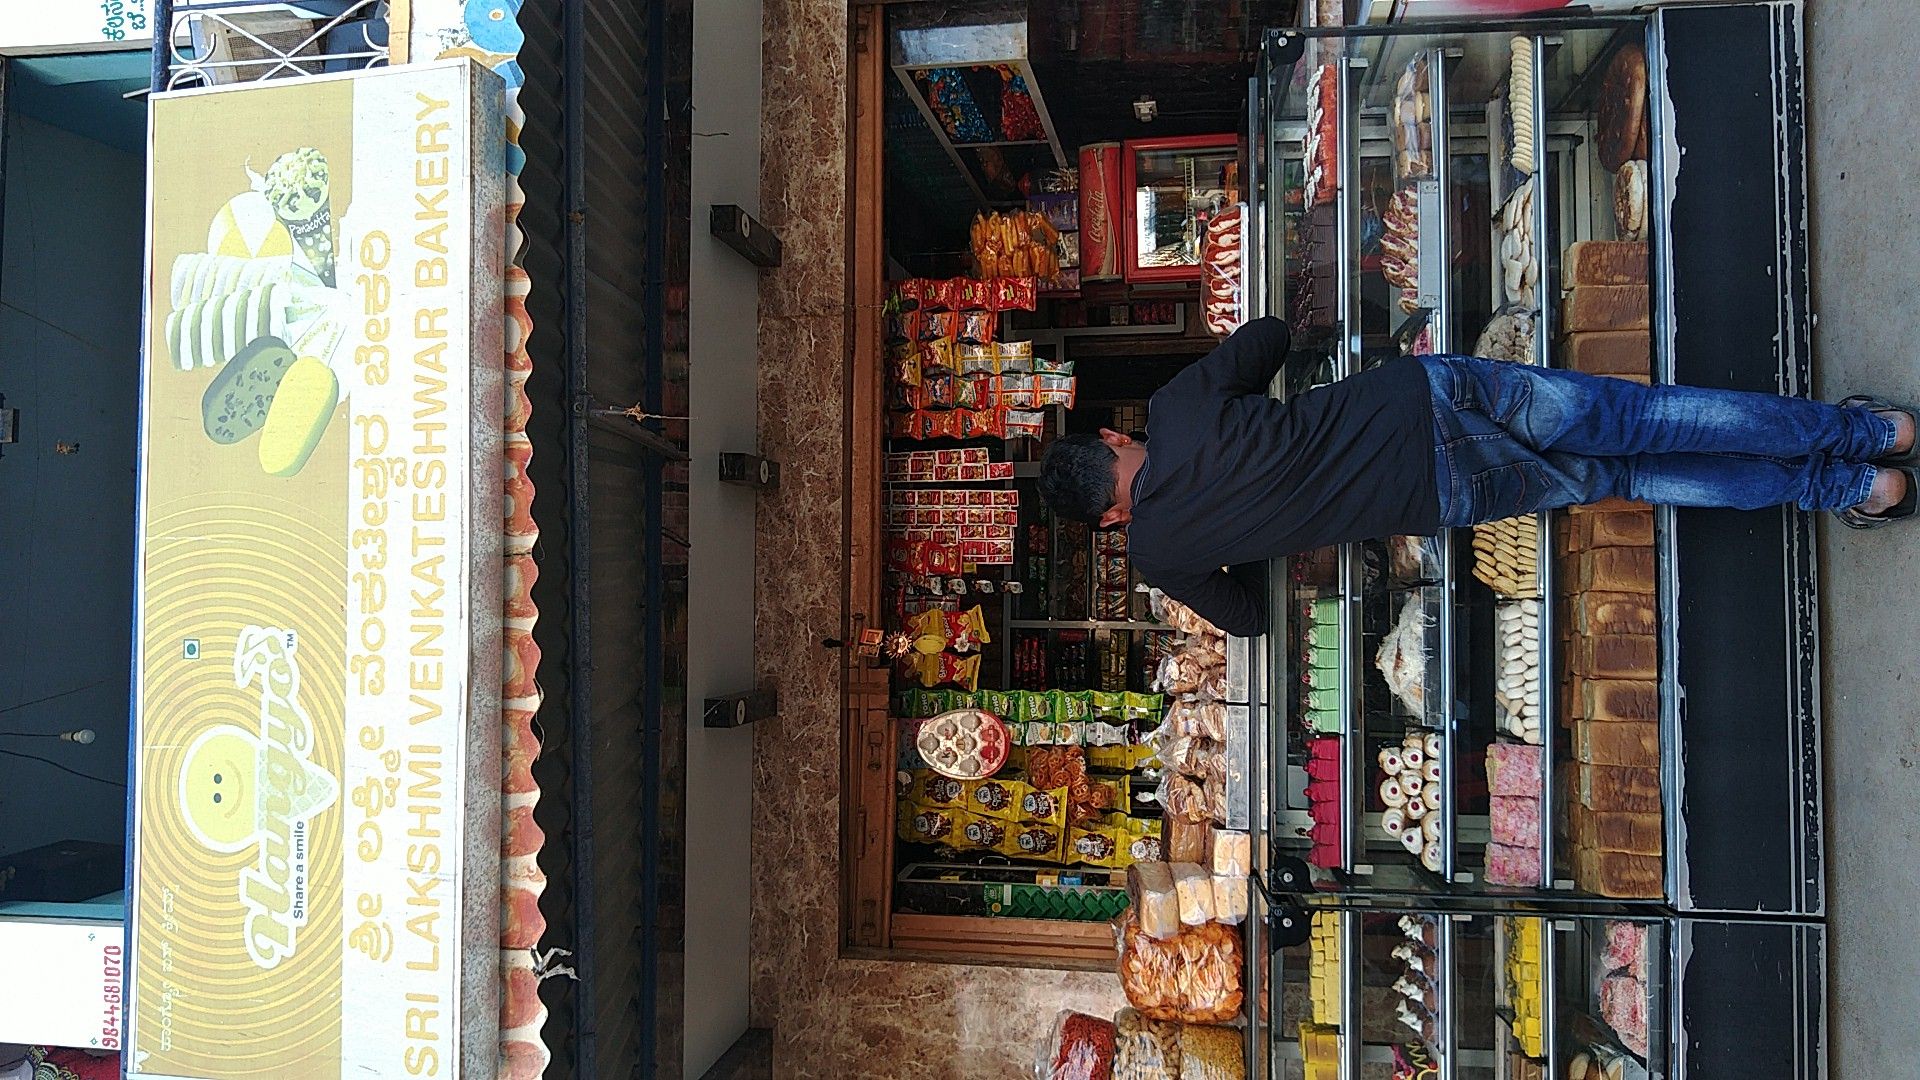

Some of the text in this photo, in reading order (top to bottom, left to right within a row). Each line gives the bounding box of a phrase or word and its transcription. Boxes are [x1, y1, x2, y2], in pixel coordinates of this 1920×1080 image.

[101, 0, 125, 40] ಕೆಲಸ
[348, 230, 408, 963] ಶ್ರೀ ಲಕ್ಷ್ಮೀ ವೆಂಕಟೇಶ್ವರ ಬೇಕರಿ
[404, 92, 450, 1077] SRI LAKSHMI VENKATESHWAR BAKERY
[1028, 696, 1038, 718] YOHO
[1064, 696, 1074, 719] YOHO
[238, 633, 308, 961] Hangyo
[293, 821, 305, 919] Share a smile
[101, 946, 121, 1049] 9844681070
